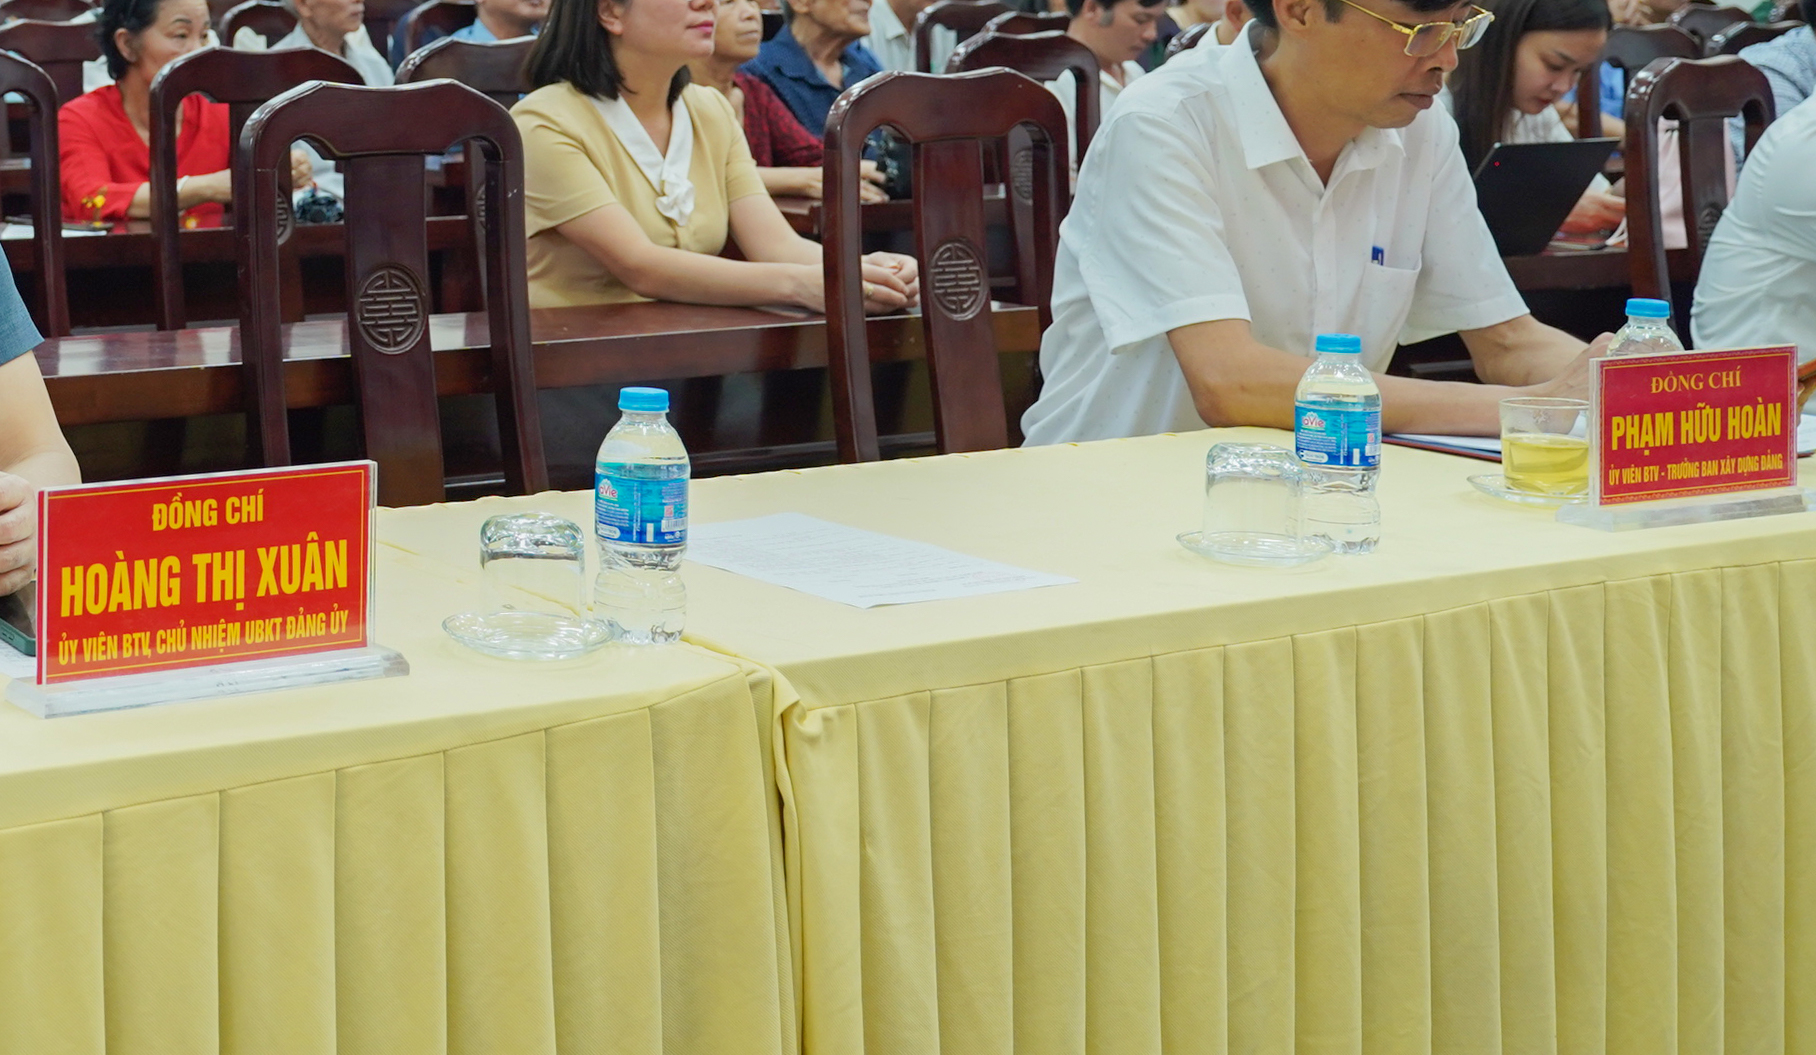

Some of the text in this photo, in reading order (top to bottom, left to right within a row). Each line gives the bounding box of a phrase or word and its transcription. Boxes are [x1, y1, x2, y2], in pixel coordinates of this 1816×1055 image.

[1651, 365, 1742, 394] ĐỒNG CHÍ
[1611, 397, 1782, 456] PHẠM HỮU HOÀN
[1609, 464, 1620, 486] ỦY
[1622, 464, 1642, 484] VIÊN
[1643, 465, 1660, 483] BTV
[1667, 458, 1700, 480] TRƯỞNG
[1701, 460, 1719, 477] BAN
[1720, 455, 1737, 475] XÂY
[1761, 449, 1783, 471] ĐẢNG
[152, 489, 264, 531] ĐỒNG CHÍ
[60, 532, 348, 617] HOÀNG THỊ XUÂN
[59, 603, 349, 665] ỦY VIÊN BTV, CHỦ NHIỆM UBKT ĐẢNG ỦY
